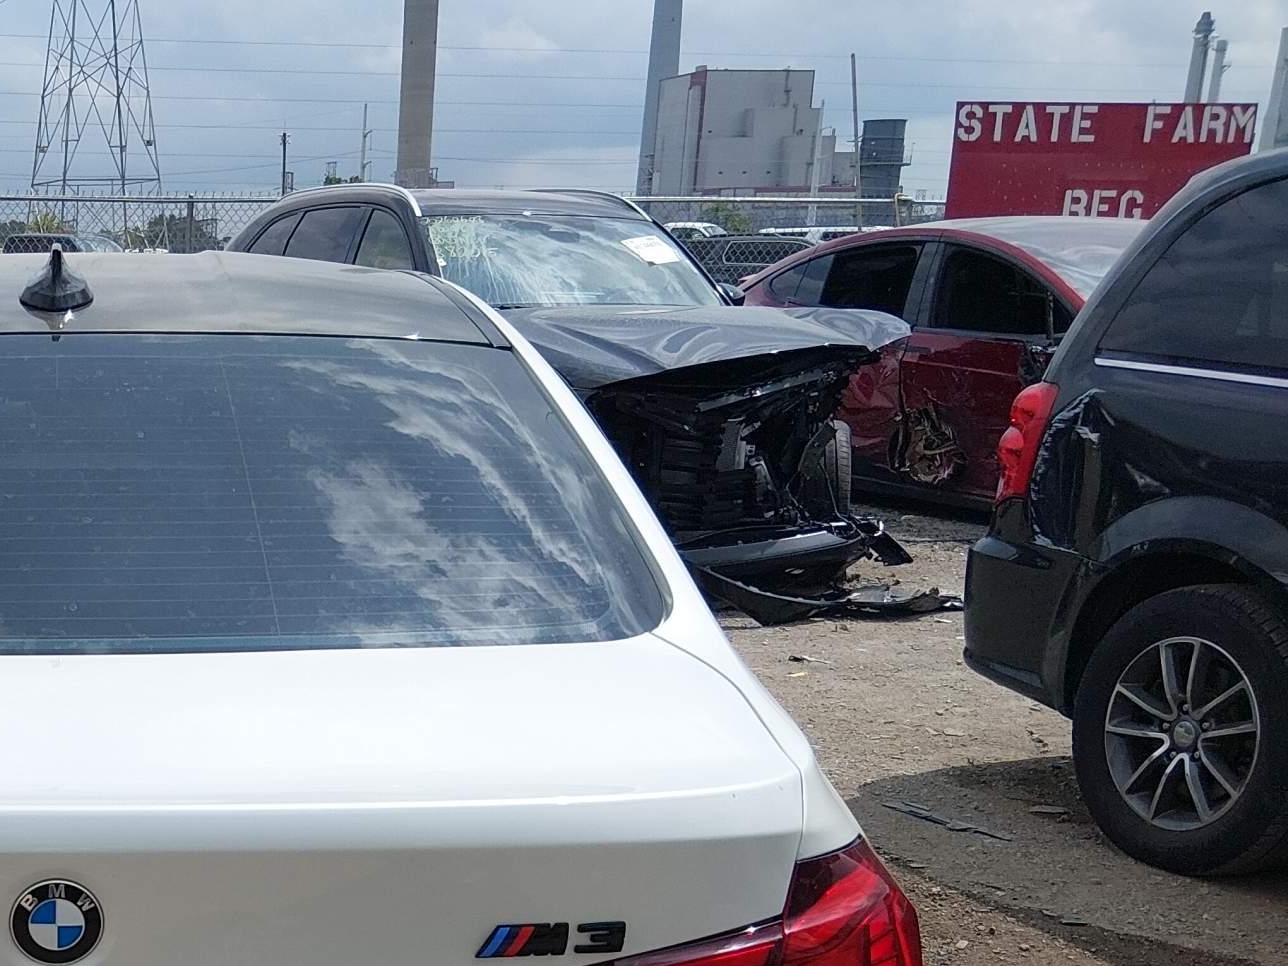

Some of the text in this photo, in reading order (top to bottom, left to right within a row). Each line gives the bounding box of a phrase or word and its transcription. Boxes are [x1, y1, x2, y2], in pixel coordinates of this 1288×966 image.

[957, 104, 1257, 144] STATE FARM
[20, 884, 95, 912] BMW
[476, 921, 626, 958] M3
